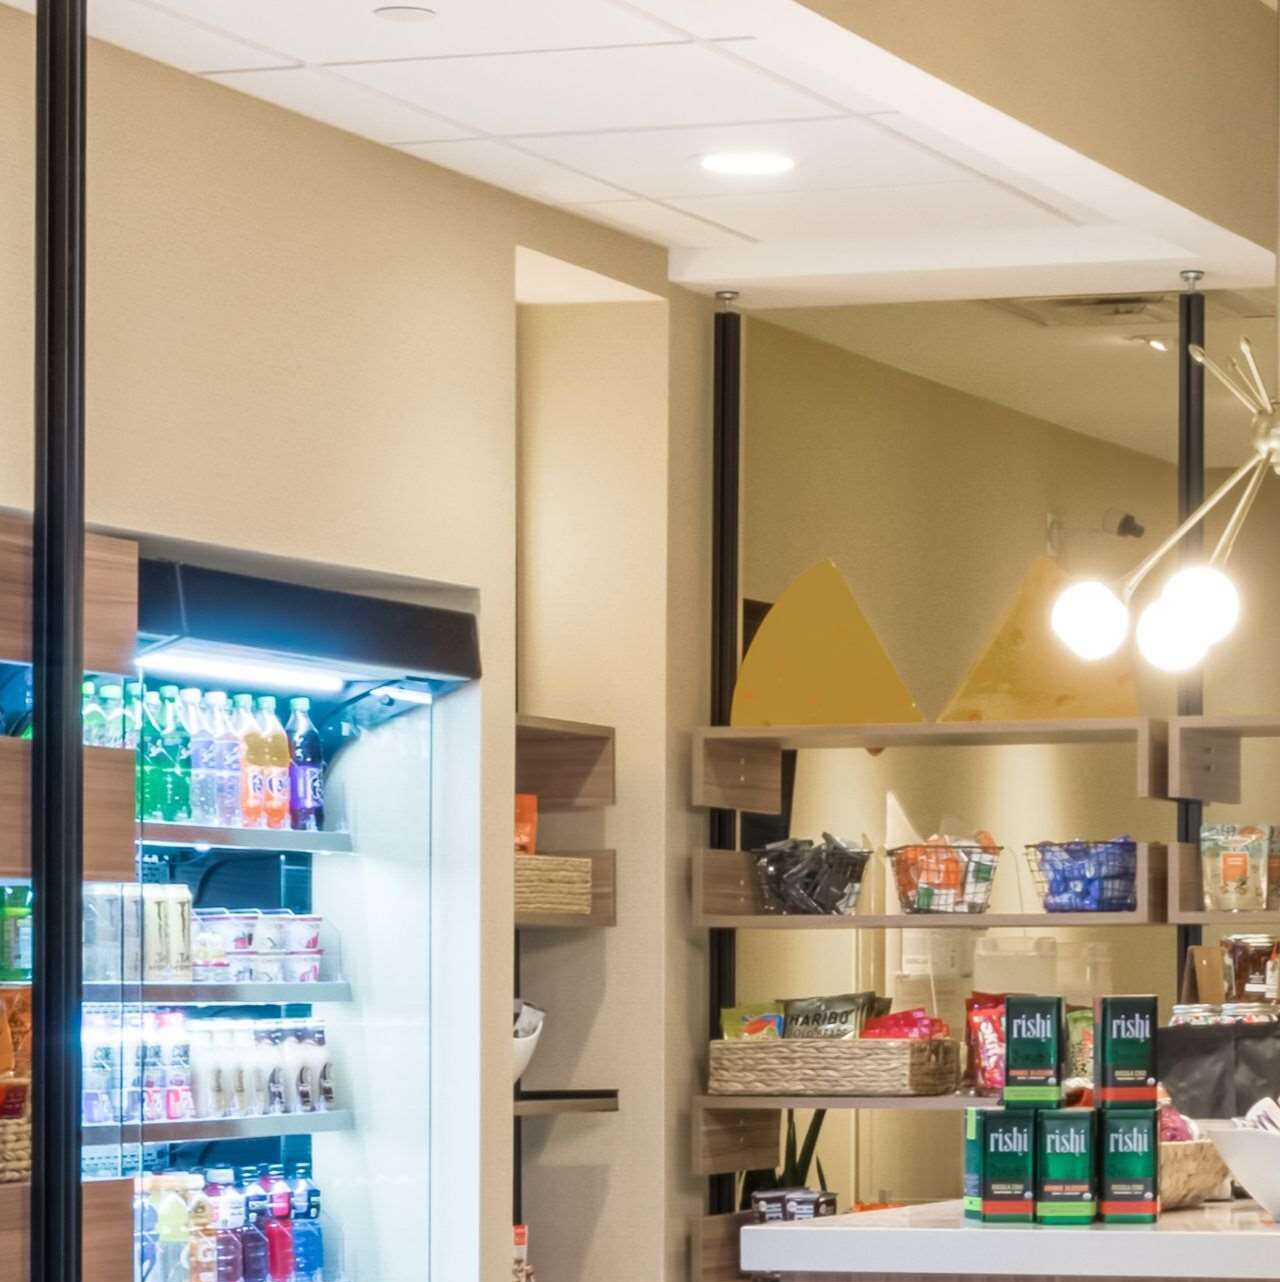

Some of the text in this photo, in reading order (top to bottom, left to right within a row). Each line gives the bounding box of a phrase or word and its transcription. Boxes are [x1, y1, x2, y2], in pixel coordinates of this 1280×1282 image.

[789, 1010, 850, 1027] HARIBO
[1012, 1012, 1053, 1043] rishi
[1111, 1012, 1151, 1043] rishi
[989, 1126, 1029, 1157] rishi
[1045, 1127, 1087, 1158] rishi
[1109, 1126, 1149, 1157] rishi
